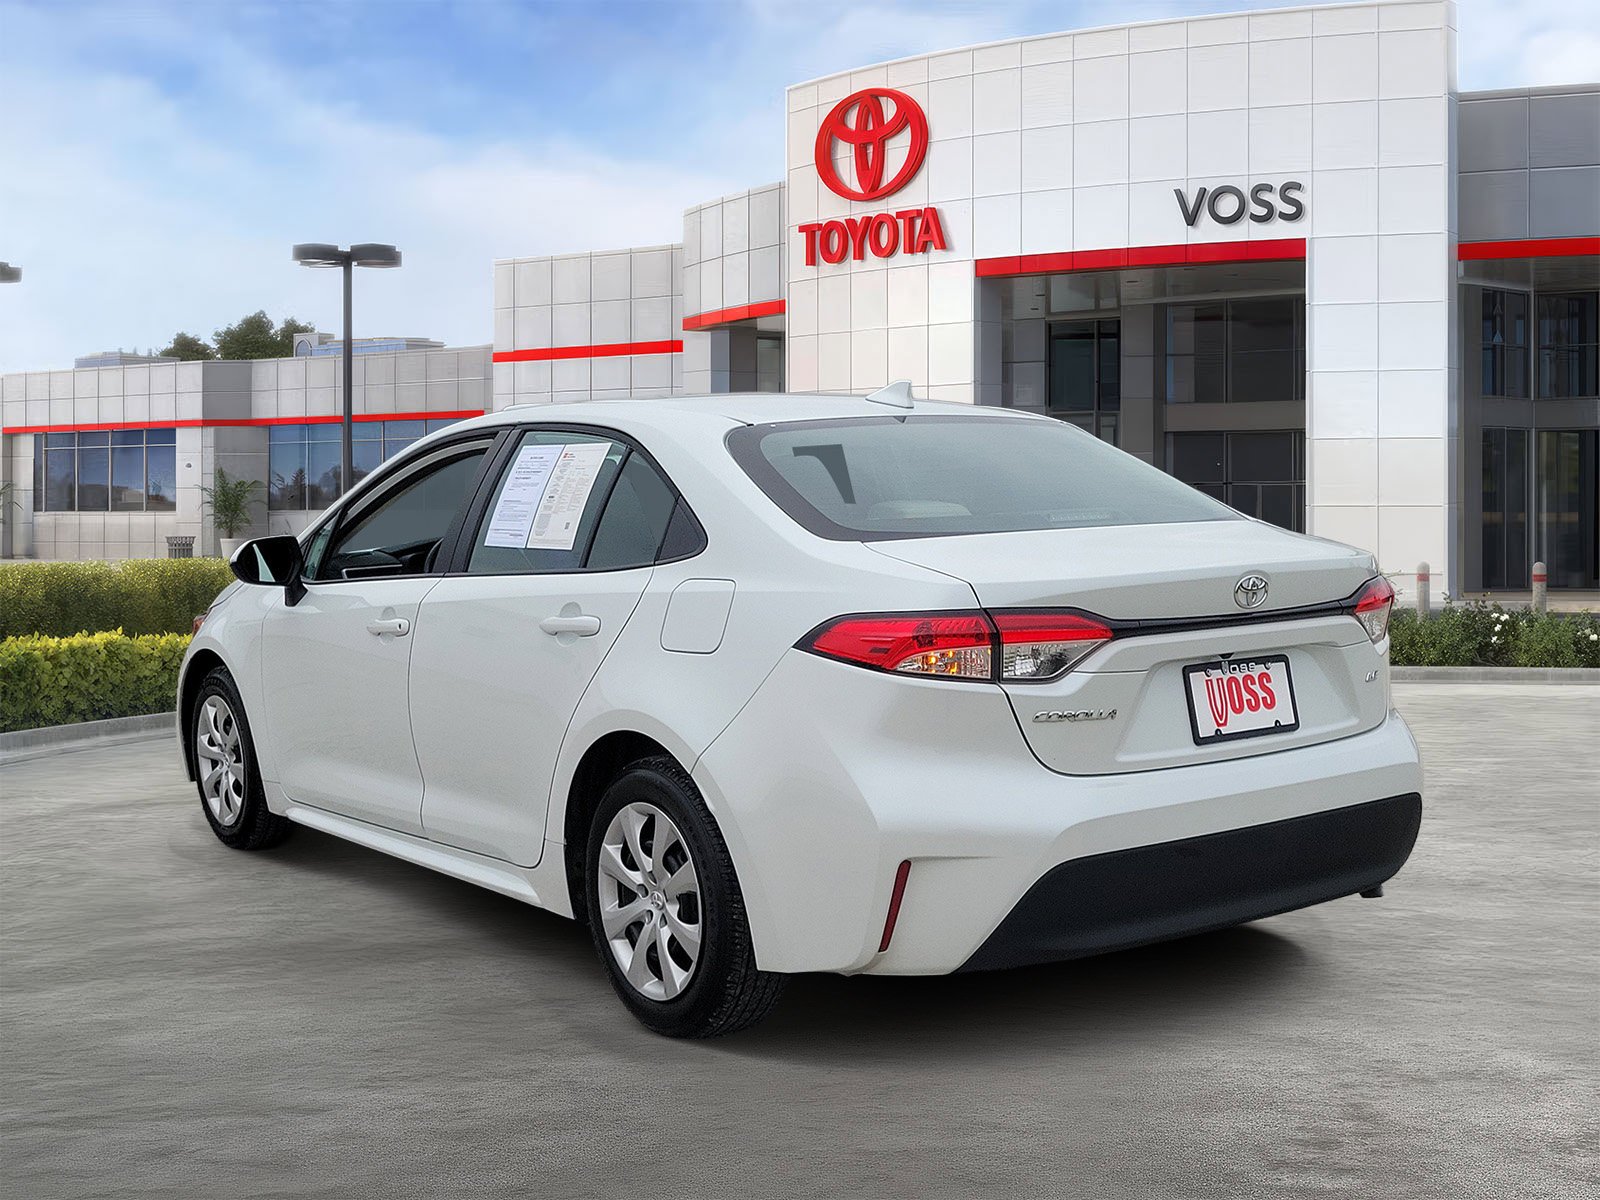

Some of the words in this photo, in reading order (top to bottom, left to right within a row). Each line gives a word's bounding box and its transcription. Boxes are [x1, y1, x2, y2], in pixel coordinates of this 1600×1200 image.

[1173, 181, 1304, 226] VOSS
[798, 206, 947, 266] TOYOTA
[1032, 709, 1117, 723] COROLLA
[1205, 672, 1276, 728] VOSS
